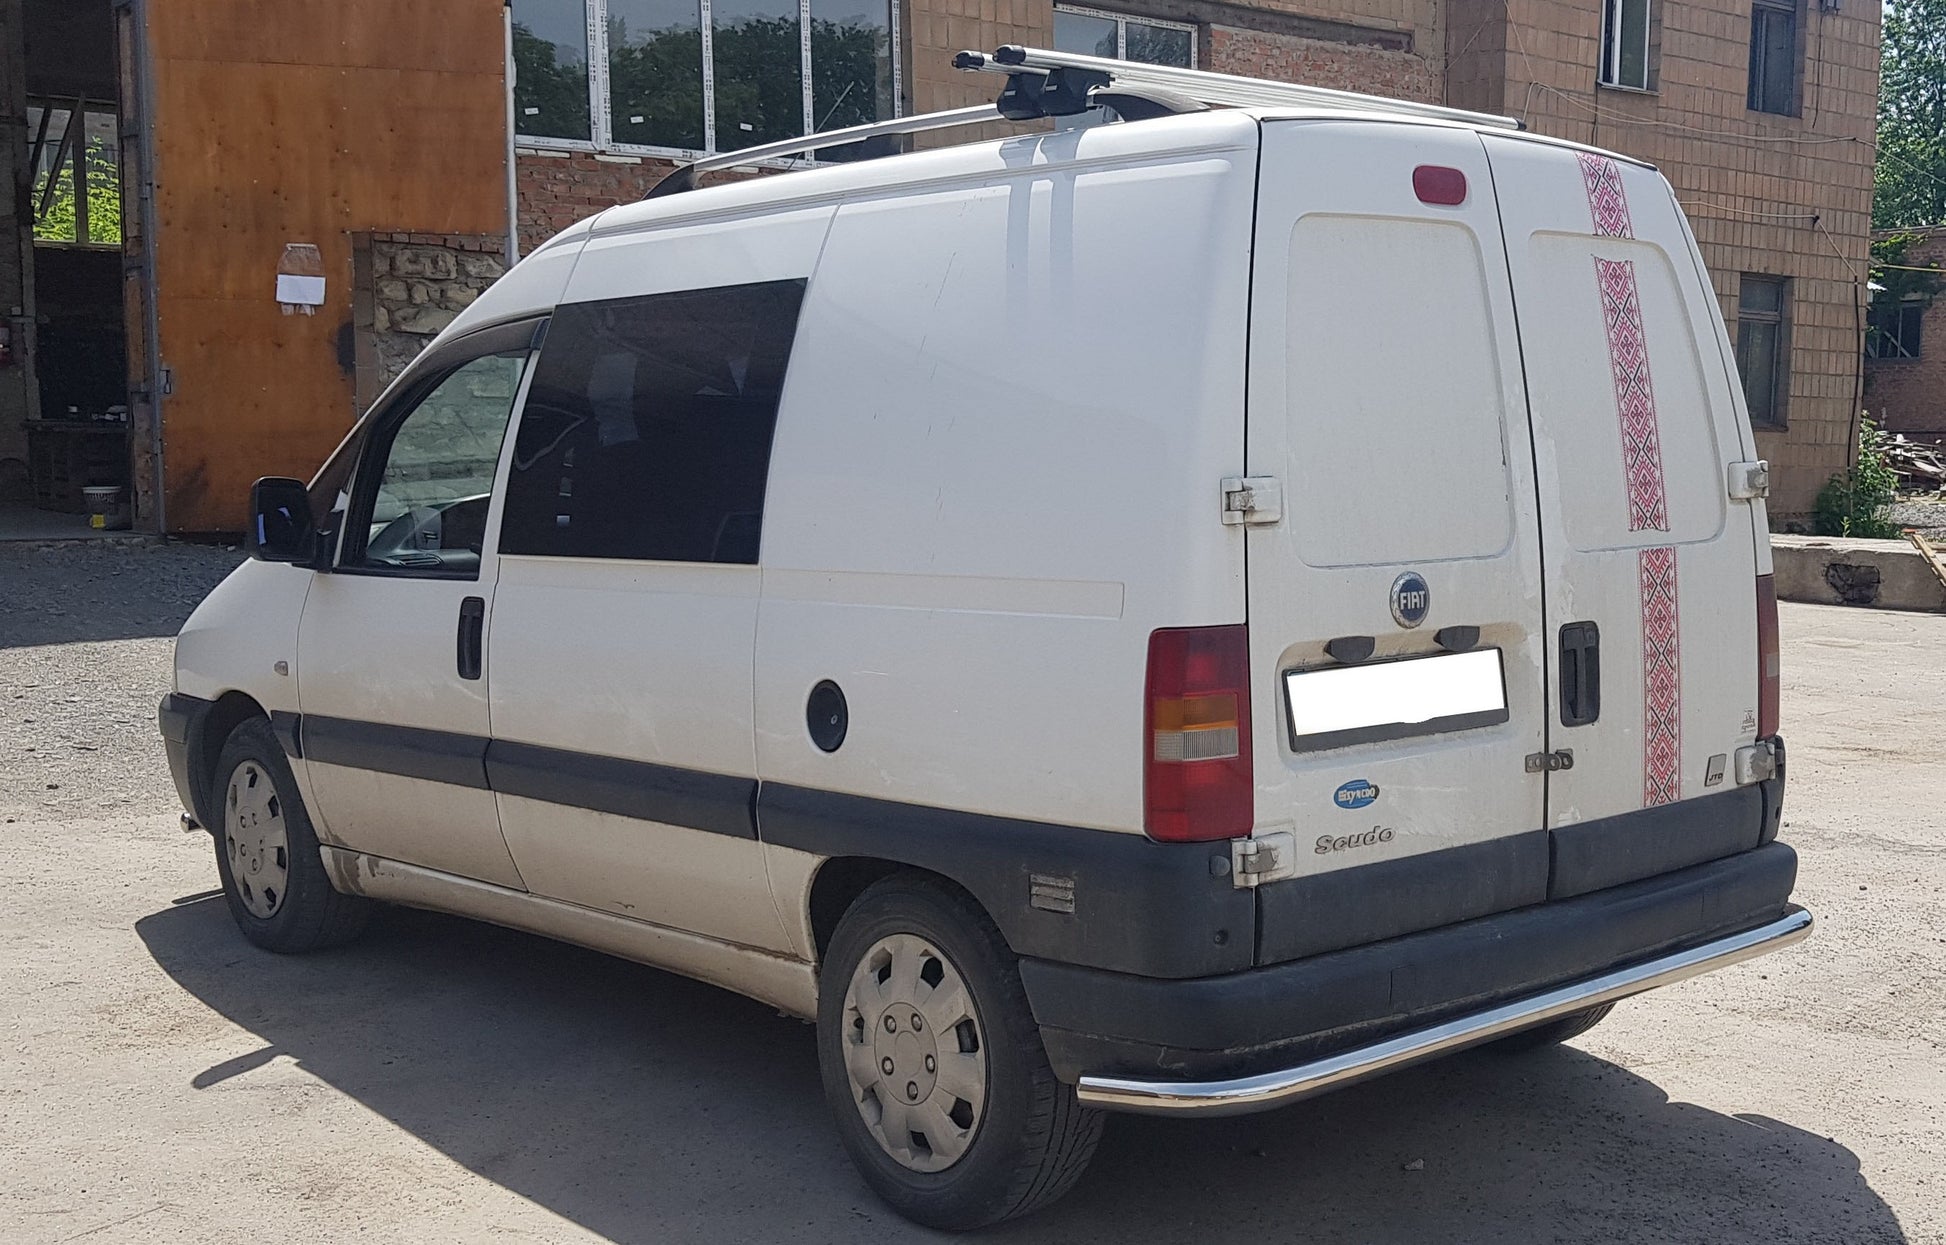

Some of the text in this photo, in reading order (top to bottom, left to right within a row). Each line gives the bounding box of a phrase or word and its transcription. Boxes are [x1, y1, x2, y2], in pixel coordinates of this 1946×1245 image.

[1400, 590, 1425, 610] FIAT
[1709, 772, 1723, 781] JTD
[1314, 825, 1396, 854] Scudo
